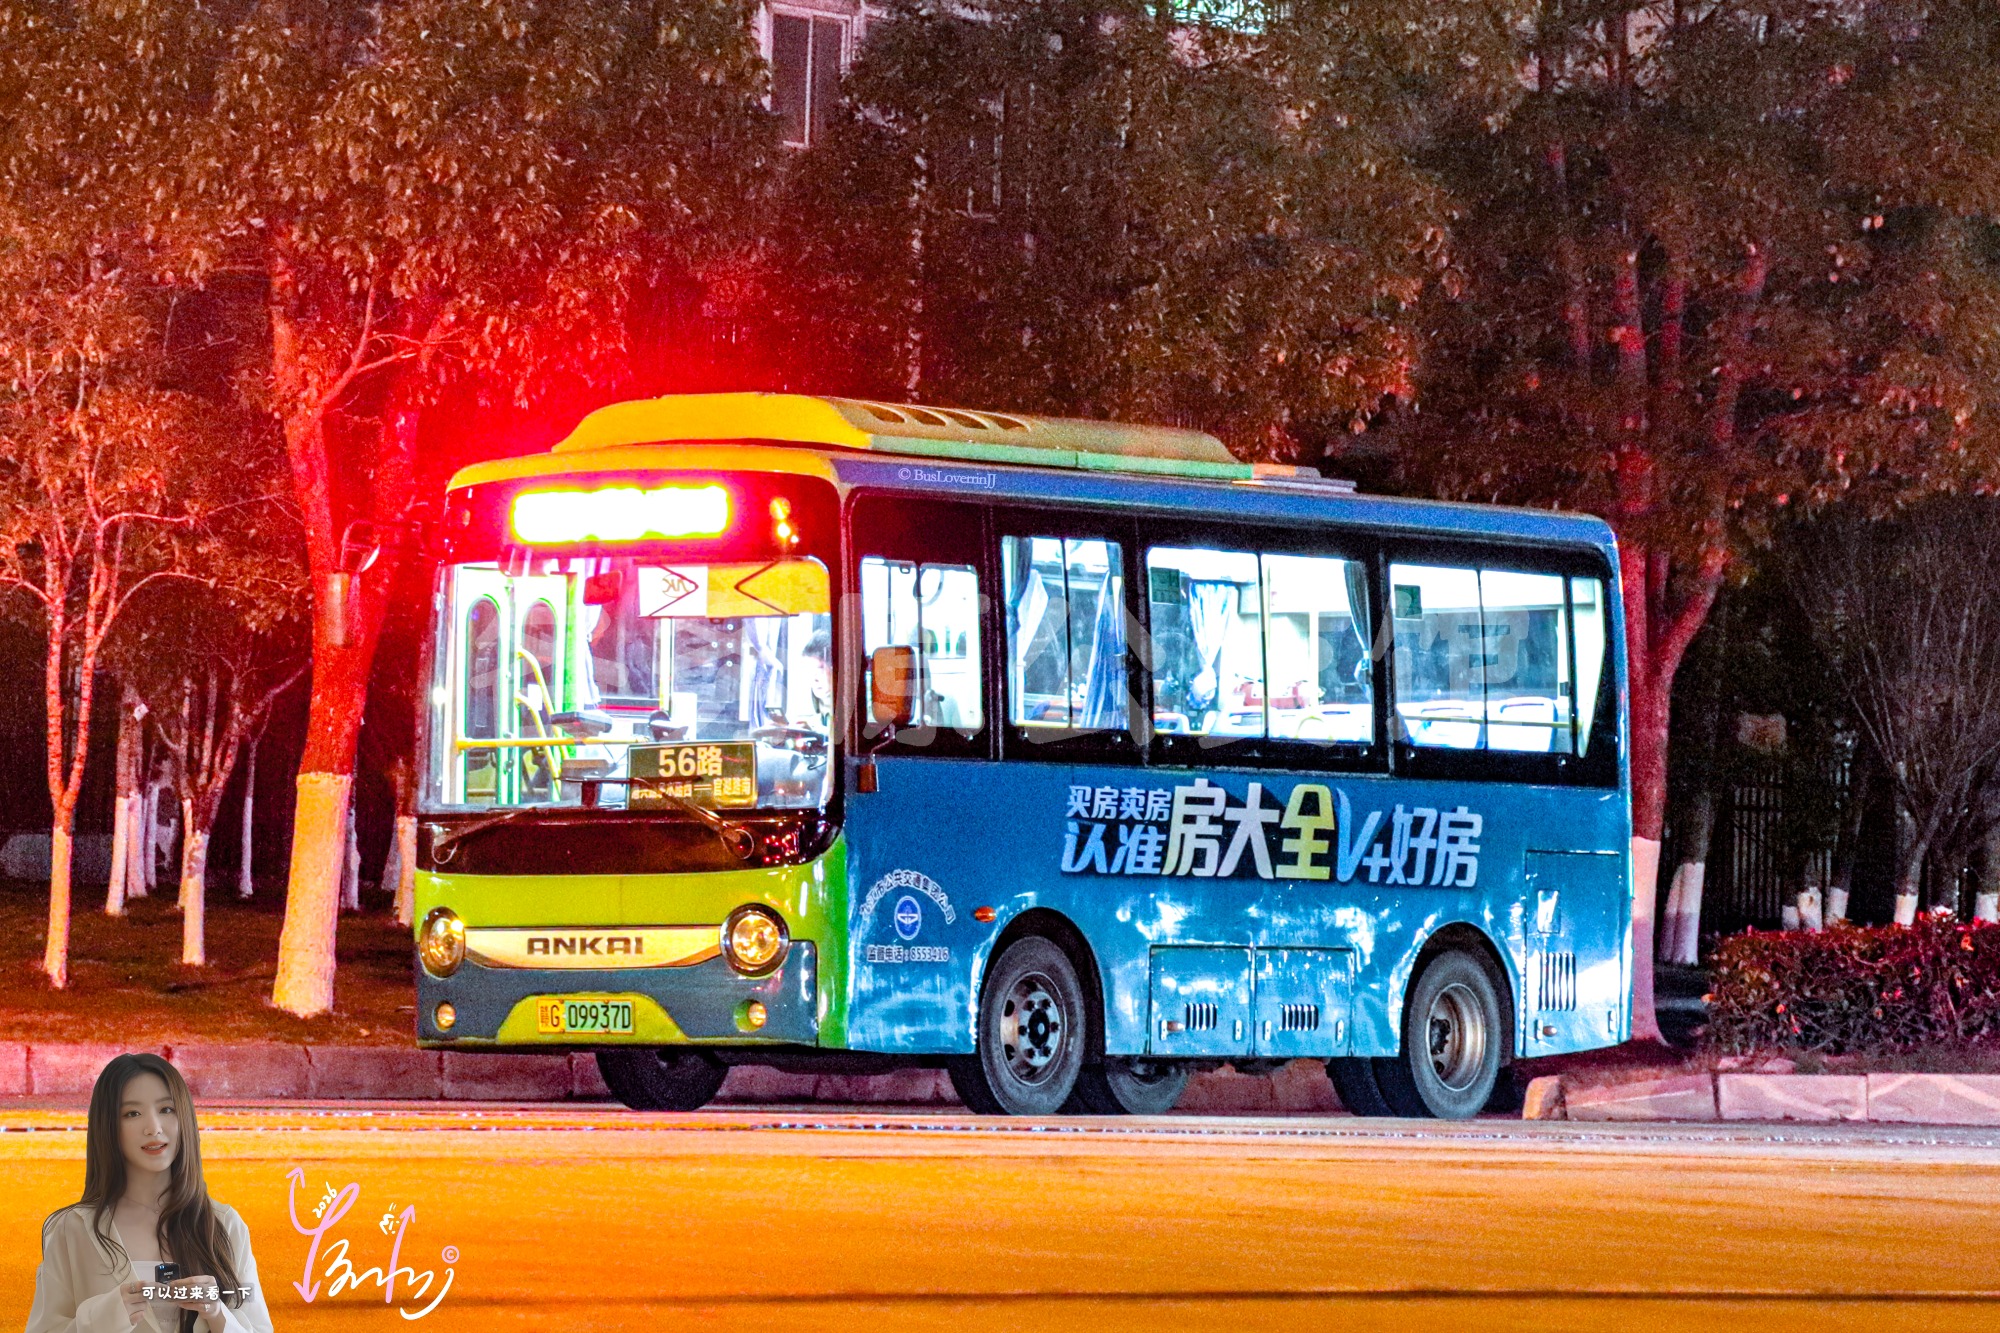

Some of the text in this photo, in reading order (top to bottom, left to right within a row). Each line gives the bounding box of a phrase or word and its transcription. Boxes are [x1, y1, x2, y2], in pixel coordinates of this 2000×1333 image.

[658, 746, 723, 777] 56路
[1067, 785, 1172, 821] 买房卖房
[1162, 778, 1335, 880] 房大全
[1061, 821, 1167, 876] 认准
[527, 936, 644, 956] ANKAI
